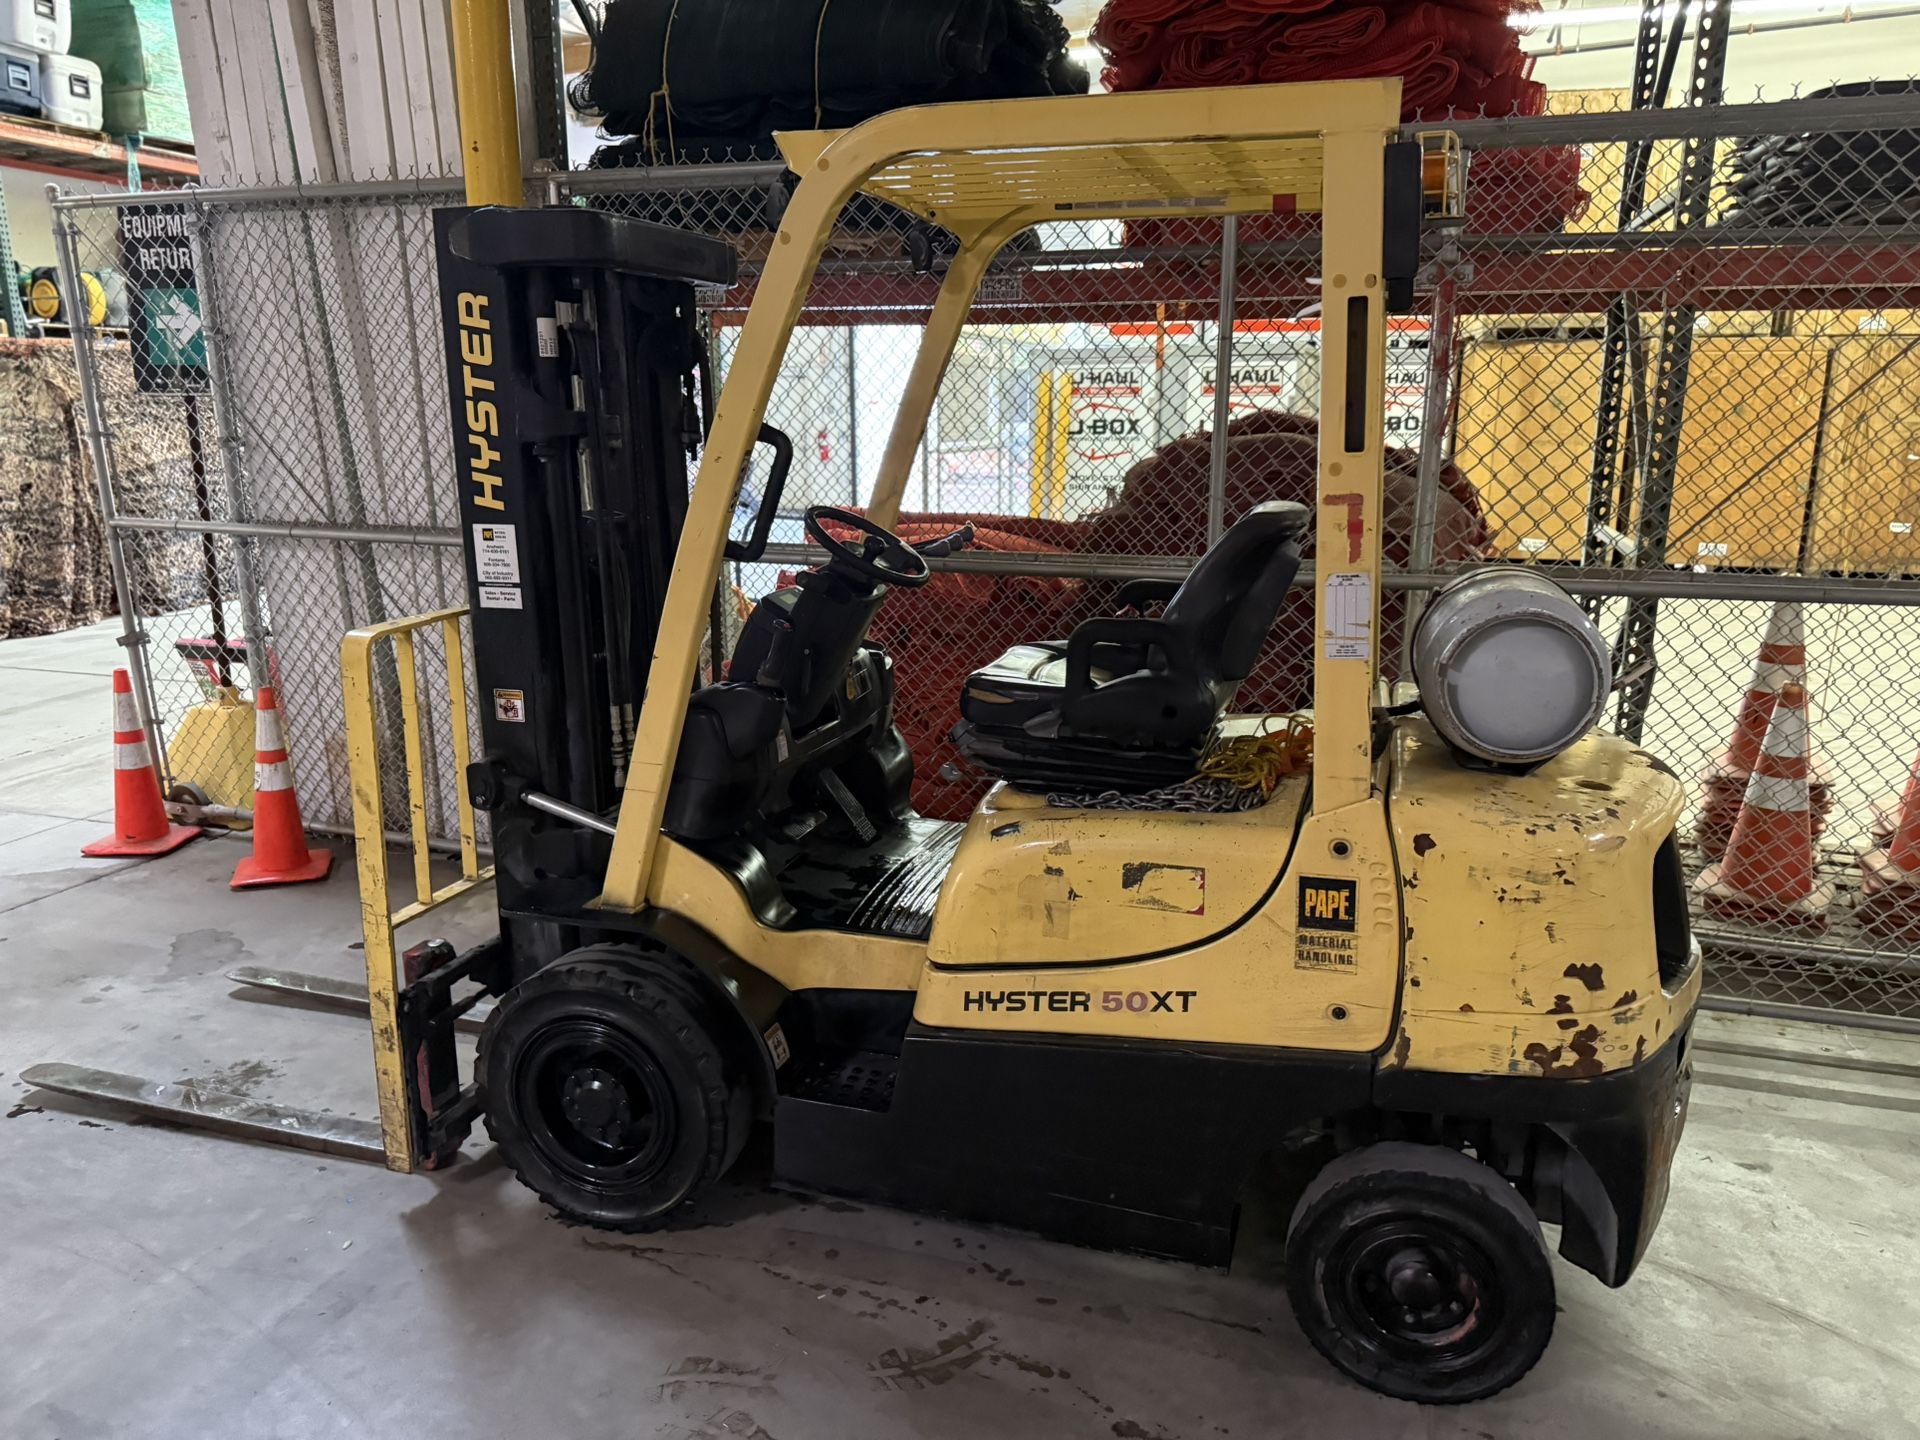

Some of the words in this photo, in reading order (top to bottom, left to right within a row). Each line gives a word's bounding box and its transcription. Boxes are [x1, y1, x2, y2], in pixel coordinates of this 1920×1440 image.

[123, 215, 189, 239] EQUIPME
[140, 247, 192, 270] RETUR
[1204, 369, 1280, 383] UHAUL
[457, 291, 505, 511] HYSTER
[1298, 934, 1353, 950] MATERIAL
[1297, 950, 1353, 965] HANDLING
[963, 990, 1091, 1012] HYSTER
[1101, 990, 1197, 1012] 50XT
